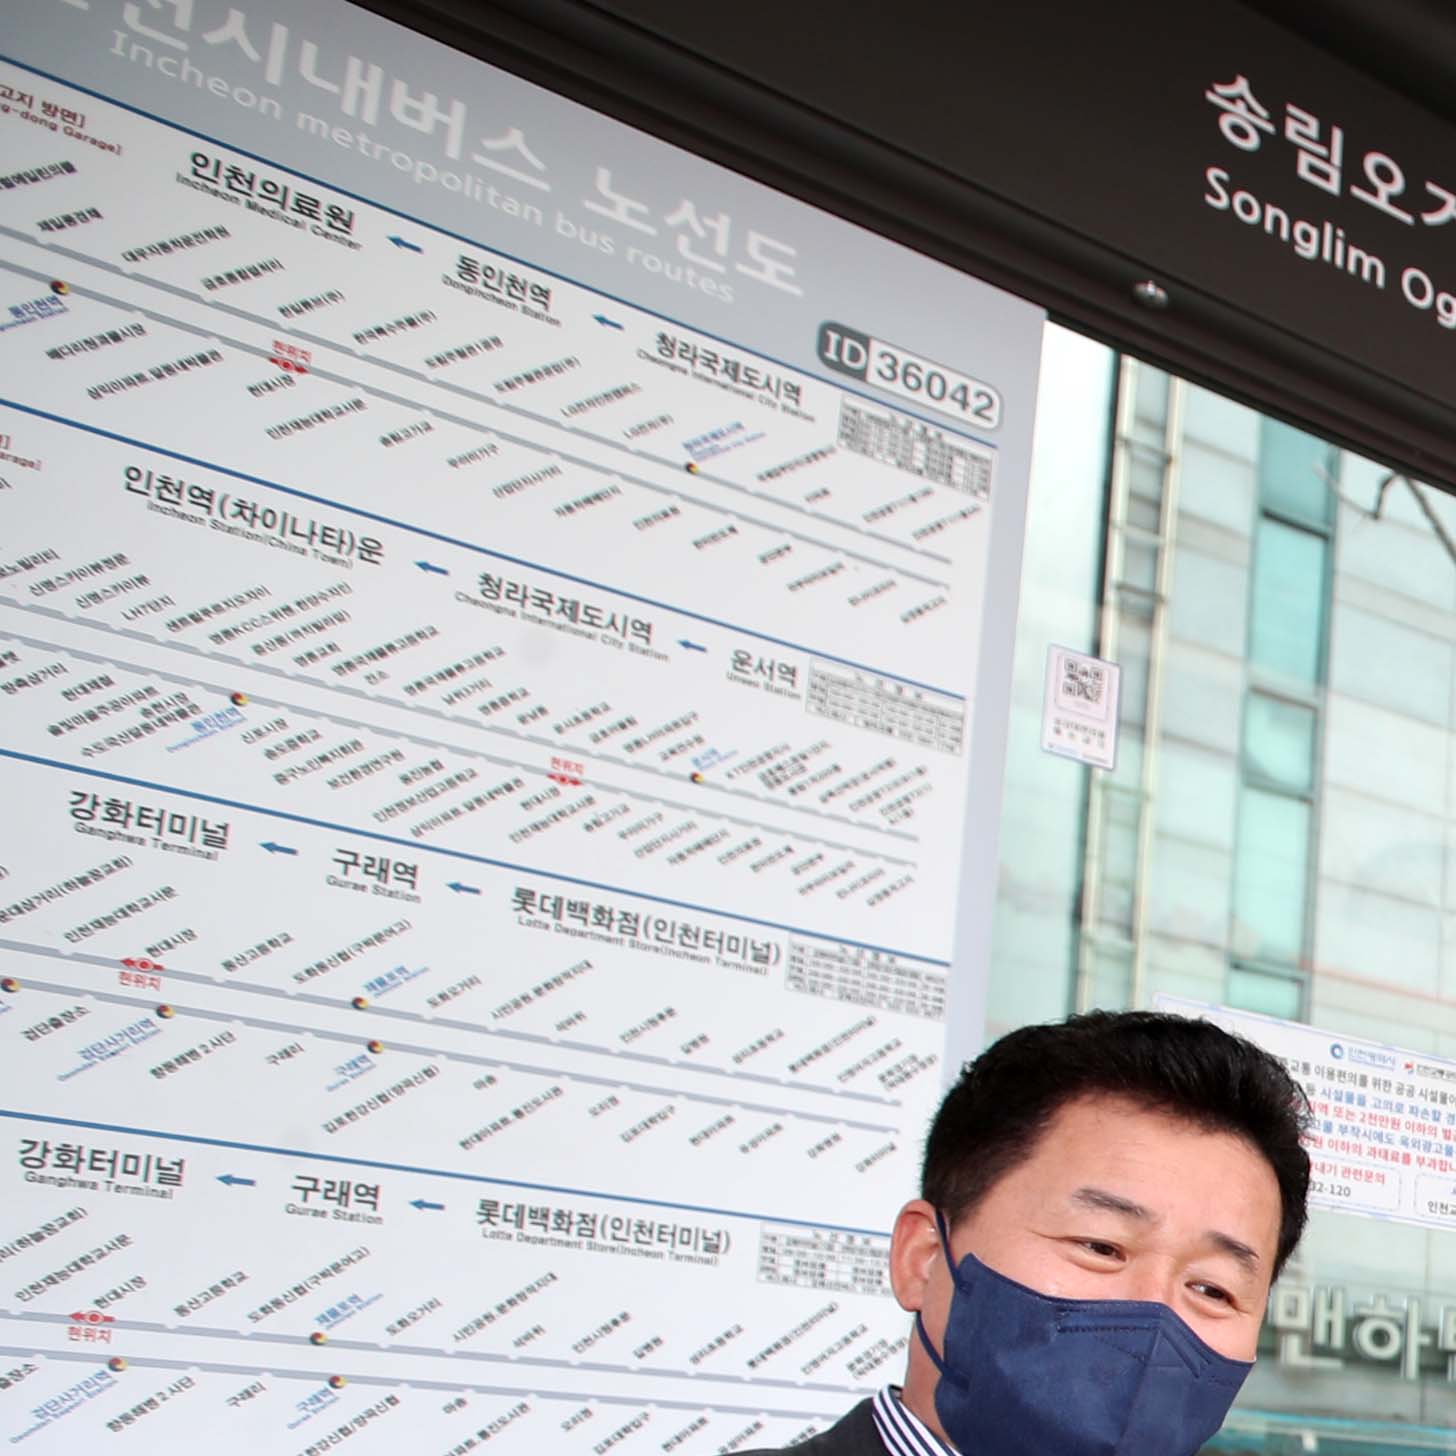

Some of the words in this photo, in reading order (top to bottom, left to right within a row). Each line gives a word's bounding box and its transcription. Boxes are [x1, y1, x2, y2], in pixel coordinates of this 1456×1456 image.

[109, 30, 284, 121] Incheon
[294, 109, 547, 230] metropolitan
[555, 209, 628, 257] bus
[624, 241, 735, 302] routes
[190, 150, 354, 234] 인천의료원
[175, 170, 239, 204] Incheon
[244, 199, 306, 230] Medical
[1205, 166, 1385, 289] Songlim
[582, 164, 803, 298] 노선도
[457, 254, 552, 313] 동인천역
[655, 331, 802, 407] 청라국제도시역
[823, 328, 869, 371] ID
[877, 351, 996, 421] 36042
[478, 572, 653, 645] 청라국제도시역
[730, 648, 797, 687] 운서역
[69, 790, 230, 850] 강화터미널
[332, 848, 420, 889] 구래역
[511, 887, 781, 966] 롯데백화점(인천터미널)
[18, 1138, 185, 1187] 강화터미널
[103, 1179, 174, 1201] Terminal
[291, 1174, 381, 1212] 구래역
[332, 1206, 384, 1226] Station
[476, 1198, 732, 1256] 롯데백화점(인천터미널)
